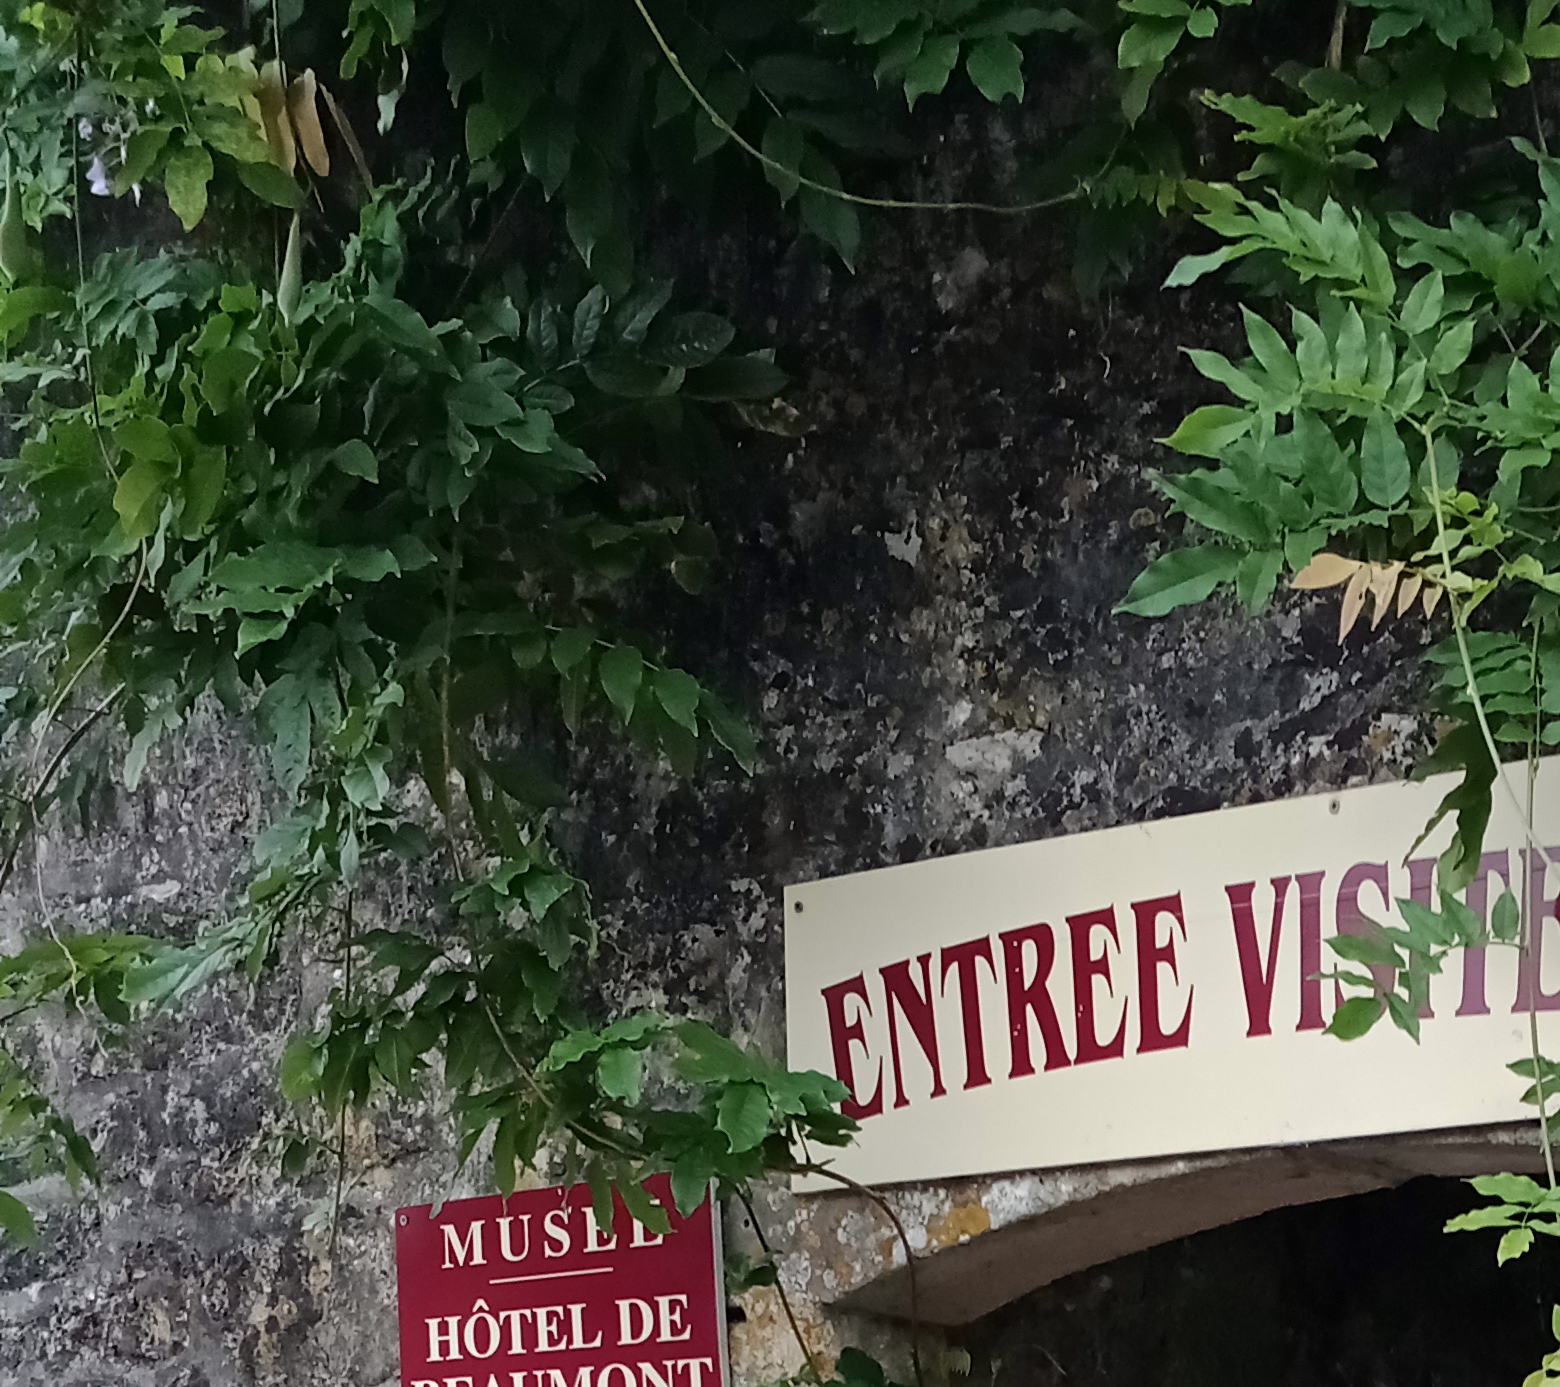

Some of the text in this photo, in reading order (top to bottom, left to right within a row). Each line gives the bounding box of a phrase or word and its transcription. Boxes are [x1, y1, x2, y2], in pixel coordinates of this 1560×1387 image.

[819, 889, 1195, 1120] ENTREE
[424, 1293, 693, 1363] HÔTEL DE
